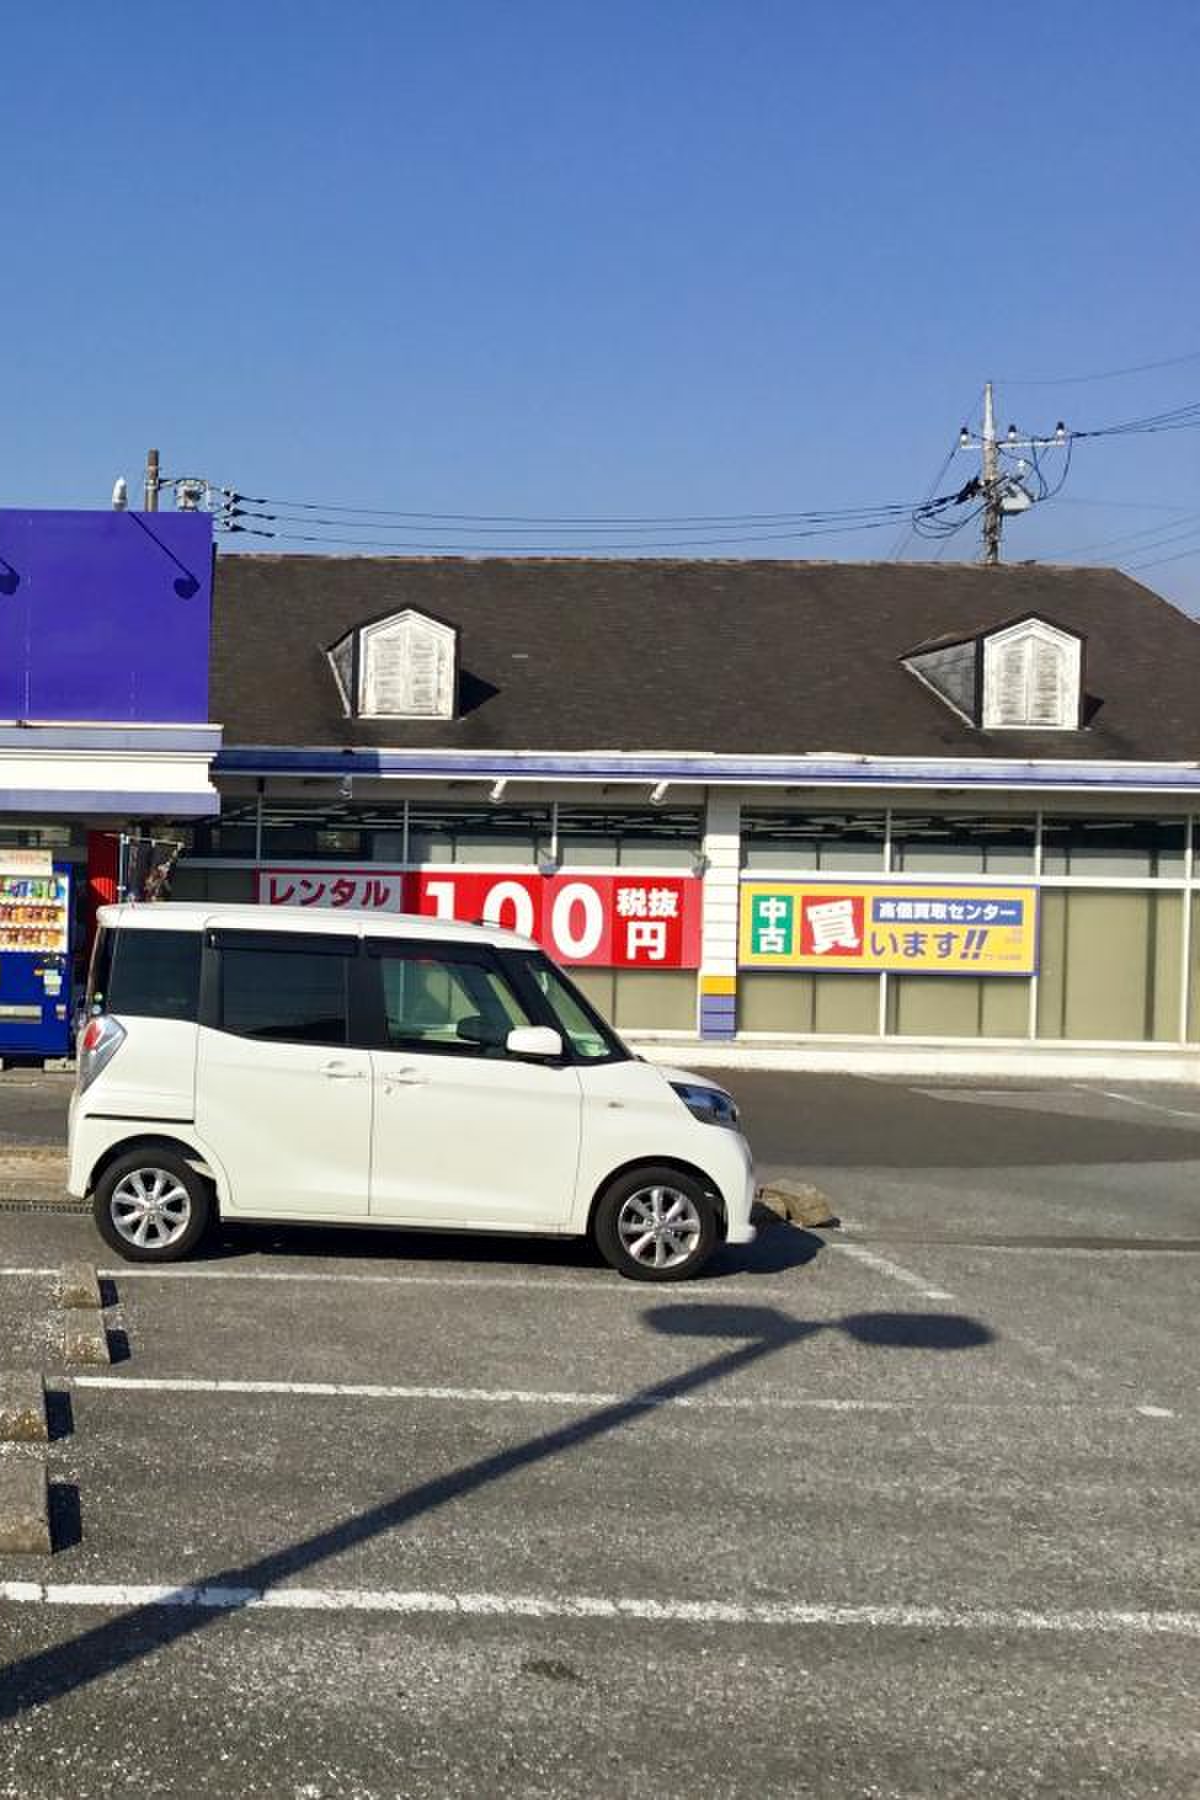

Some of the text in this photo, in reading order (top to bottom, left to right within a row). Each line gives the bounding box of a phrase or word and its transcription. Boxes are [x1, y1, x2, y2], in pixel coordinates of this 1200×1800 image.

[269, 878, 390, 907] レンタル
[615, 887, 678, 918] 税抜
[425, 880, 604, 960] 100
[758, 897, 787, 953] 中古
[626, 922, 667, 961] 円
